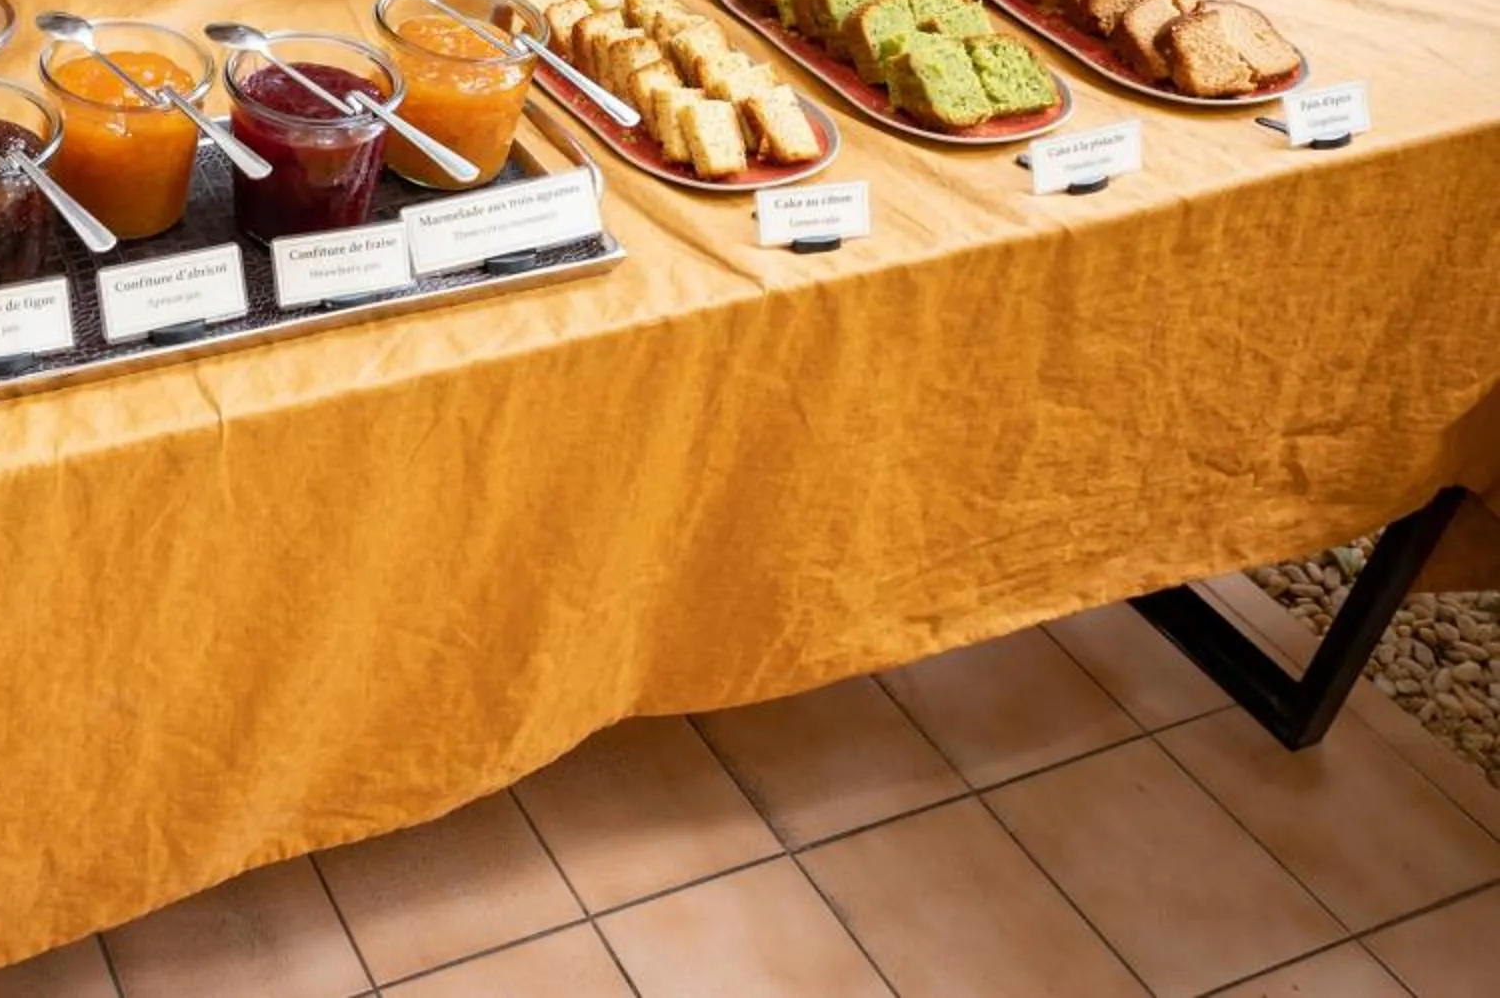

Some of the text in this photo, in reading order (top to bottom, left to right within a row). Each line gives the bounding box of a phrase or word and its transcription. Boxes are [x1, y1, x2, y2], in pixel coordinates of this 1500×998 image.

[773, 198, 803, 208] Cake
[419, 204, 485, 227] Marmelade
[288, 238, 398, 261] Confiture de fraise
[115, 263, 228, 292] Confiture d'abricot
[5, 300, 20, 312] de
[22, 295, 56, 311] figue
